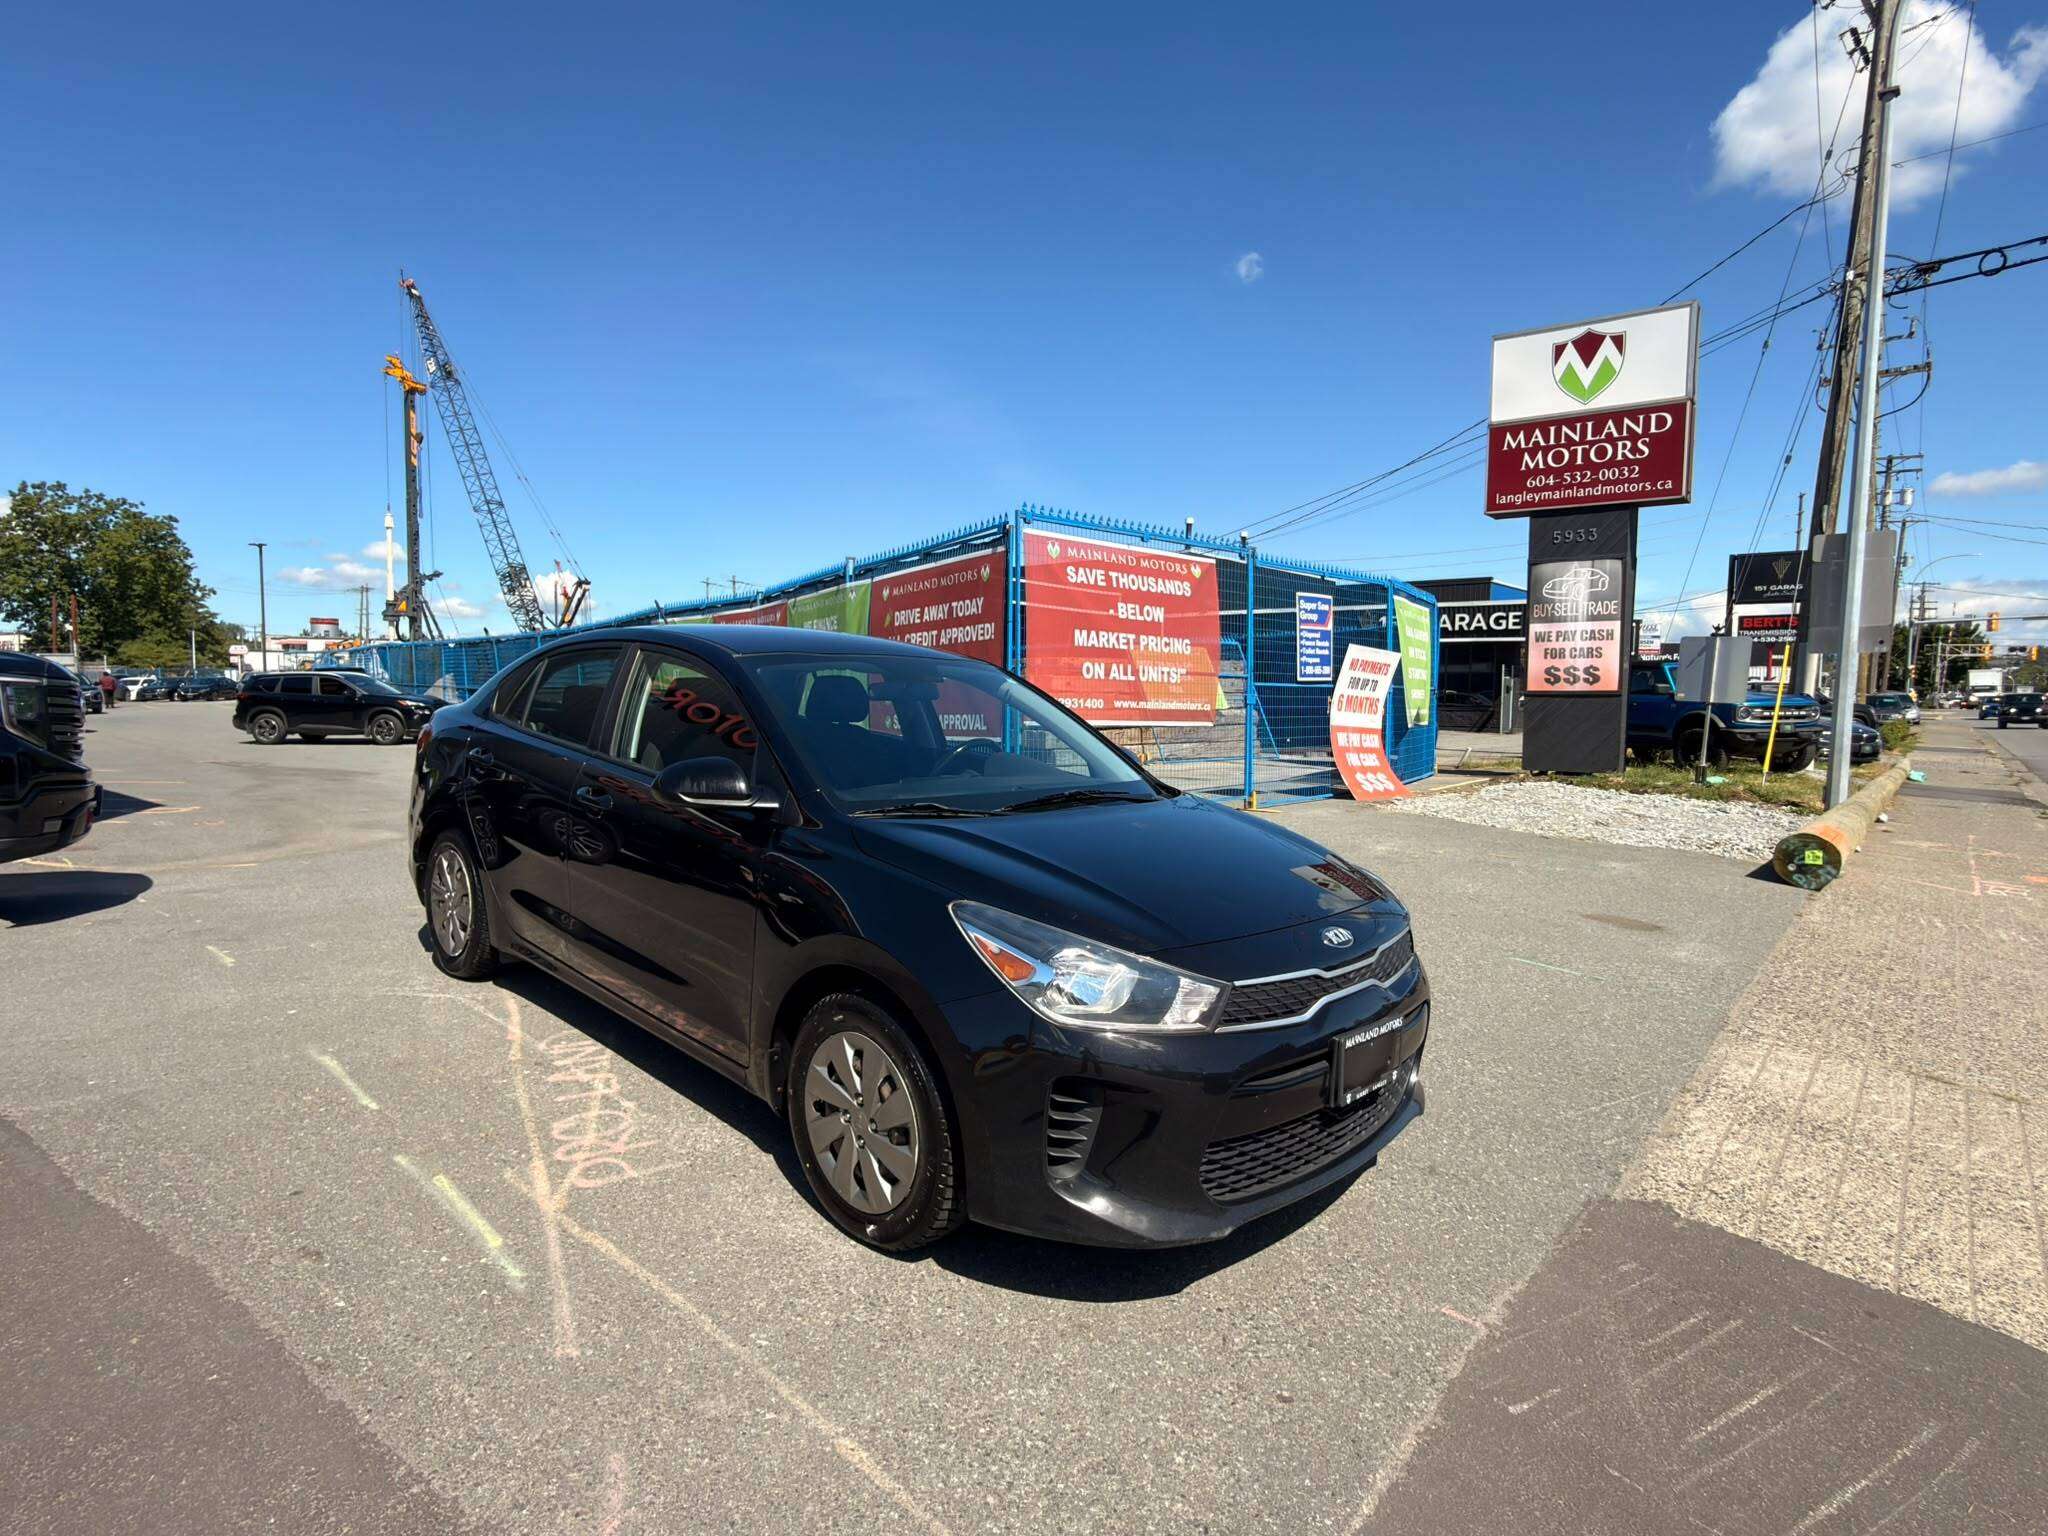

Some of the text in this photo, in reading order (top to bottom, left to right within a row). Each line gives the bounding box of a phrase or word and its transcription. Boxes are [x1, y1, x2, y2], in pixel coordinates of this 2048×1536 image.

[1503, 412, 1673, 451] MAINLAND
[1520, 437, 1650, 471] MOTORS
[1526, 465, 1640, 488] 604-532-0032
[1496, 479, 1673, 505] langleymainlandmotors.ca
[1553, 528, 1599, 544] 5933
[1066, 547, 1188, 575] MAINLAND MOTORS
[892, 569, 978, 597] MAINLAND MOTORS
[1066, 565, 1192, 597] SAVE THOUSANDS
[1769, 584, 1803, 592] GARAG
[894, 597, 985, 627] DRIVE AWAY TODAY
[1117, 602, 1165, 624] BELOW
[1300, 610, 1318, 622] Group
[1439, 612, 1523, 632] ARAGE
[1743, 617, 1799, 629] BERT'S
[940, 622, 995, 646] APPROVED!
[1074, 629, 1191, 655] MARKET PRICING
[1534, 629, 1614, 643] WE PAY CASH
[1544, 647, 1603, 660] FOR CARS
[1082, 661, 1105, 680] ON
[1109, 663, 1135, 681] ALL
[1349, 658, 1359, 672] NO
[1358, 659, 1391, 676] PAYMENTS
[1543, 665, 1601, 687] $$$
[1347, 677, 1379, 692] FOR UP TO
[1337, 694, 1380, 715] 6 MONTHS
[1325, 928, 1353, 945] KIA
[1345, 1016, 1404, 1049] MAINLAND MOTORS
